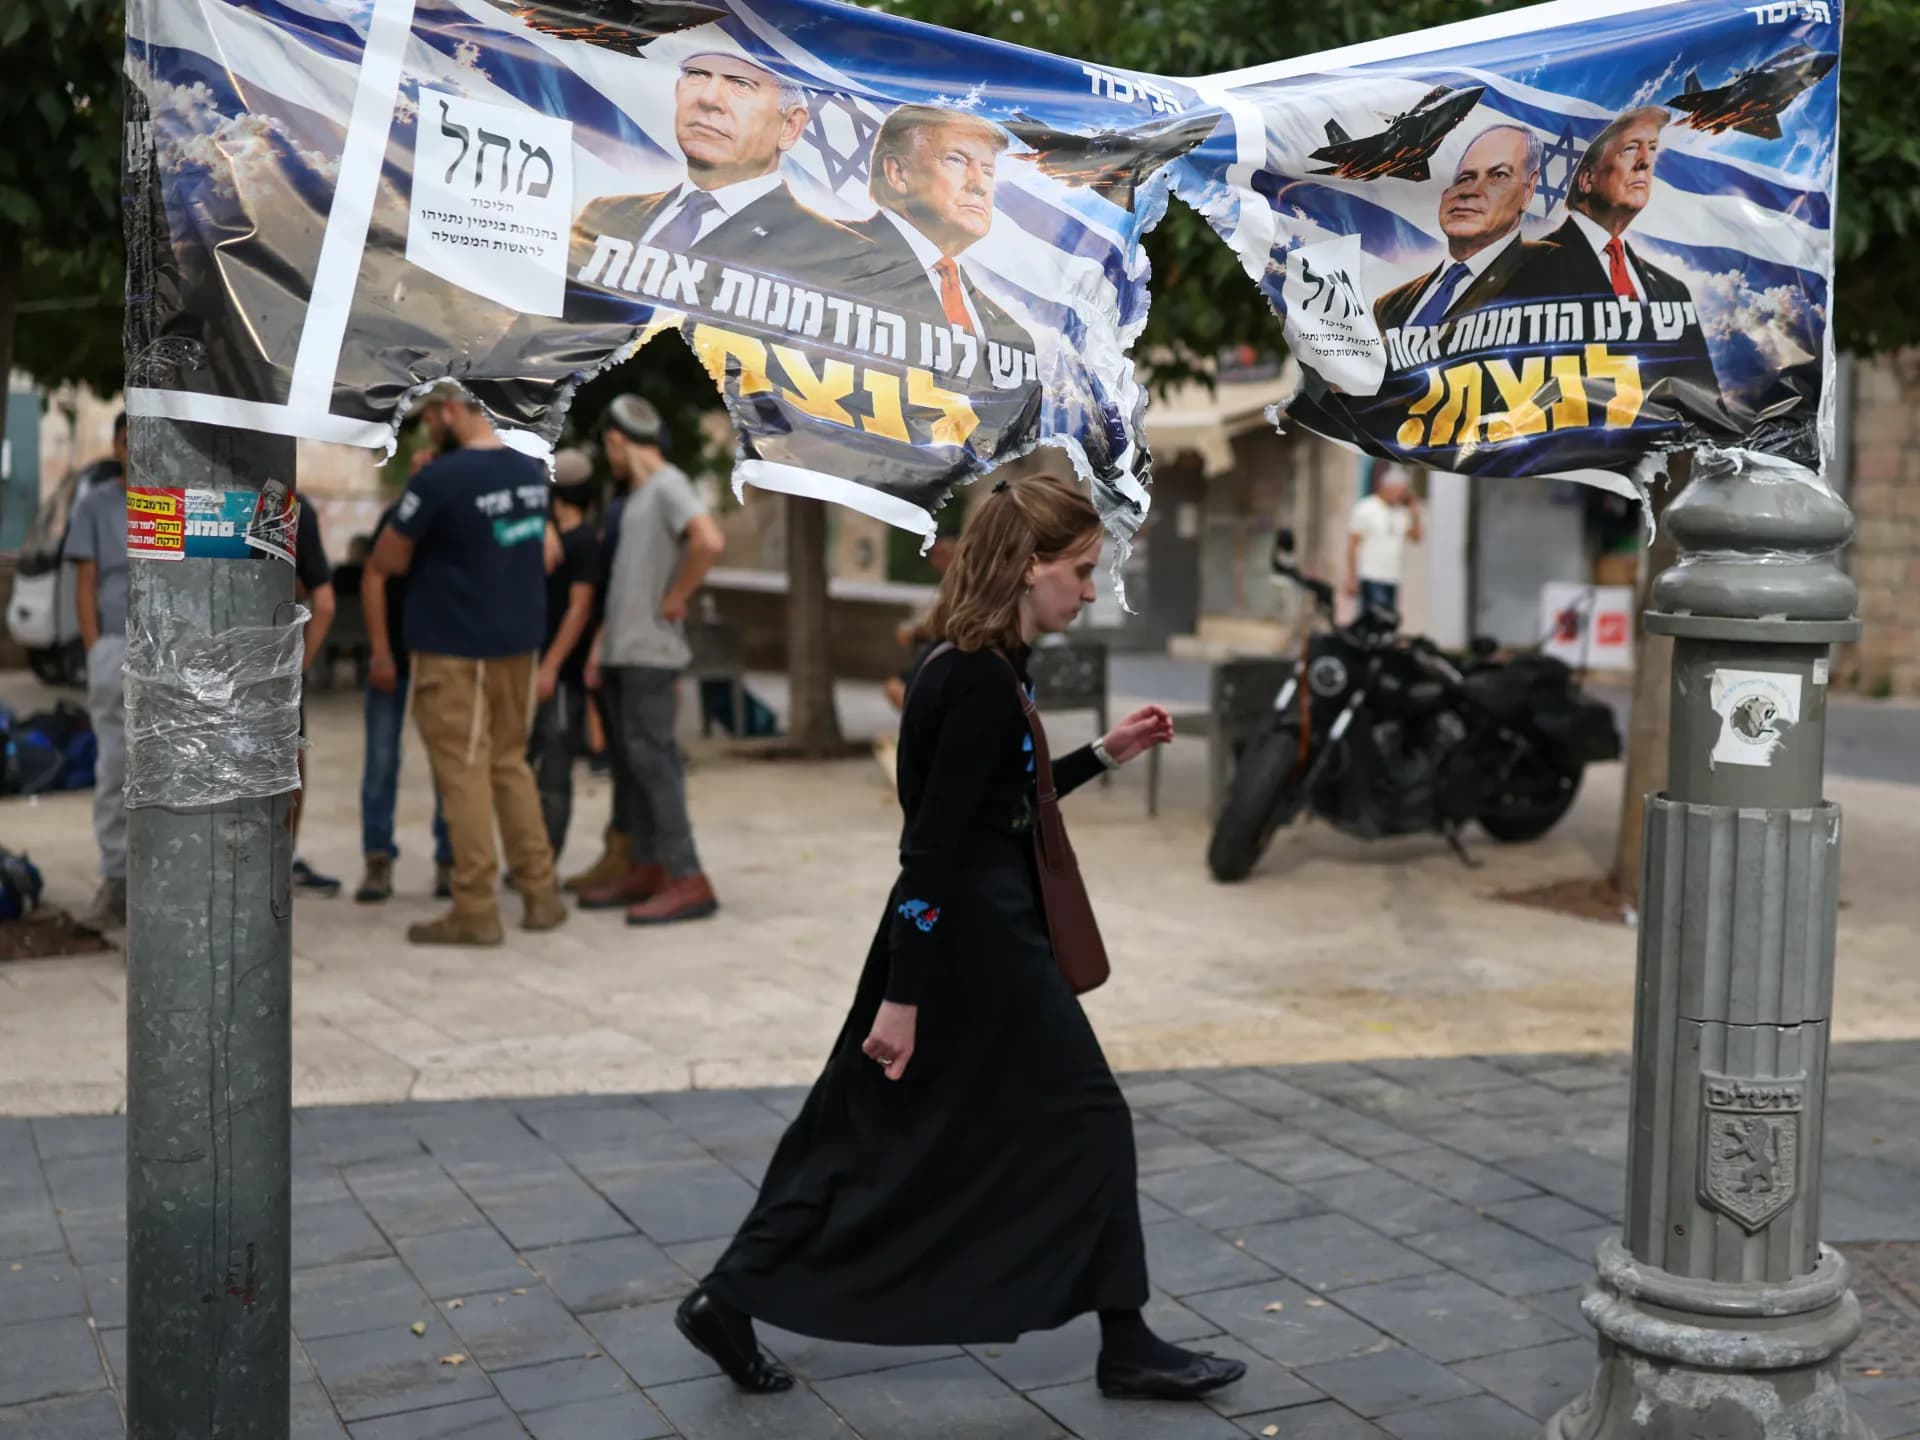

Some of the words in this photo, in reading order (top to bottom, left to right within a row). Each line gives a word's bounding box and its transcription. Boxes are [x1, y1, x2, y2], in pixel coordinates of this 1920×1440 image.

[1743, 0, 1832, 25] הליכוד
[1082, 64, 1185, 115] הליכוד
[439, 99, 554, 199] מחל
[421, 209, 463, 225] נתניהו
[467, 216, 506, 232] בנימין
[470, 196, 514, 213] הליכוד
[431, 230, 489, 248] הממשלה
[492, 239, 545, 257] לראשות
[509, 222, 558, 241] בהנהגת
[577, 234, 708, 305] אחת
[711, 266, 907, 361] הזדמנות
[1319, 317, 1353, 332] הליכוד
[1447, 301, 1584, 355] הזדמנות
[1594, 296, 1644, 342] לנו
[1650, 298, 1698, 342] יש
[919, 321, 978, 379] לנו
[988, 340, 1037, 390] יש
[1335, 349, 1372, 358] לראשות
[1386, 318, 1454, 372] אחת
[1395, 343, 1644, 449] לנצח!
